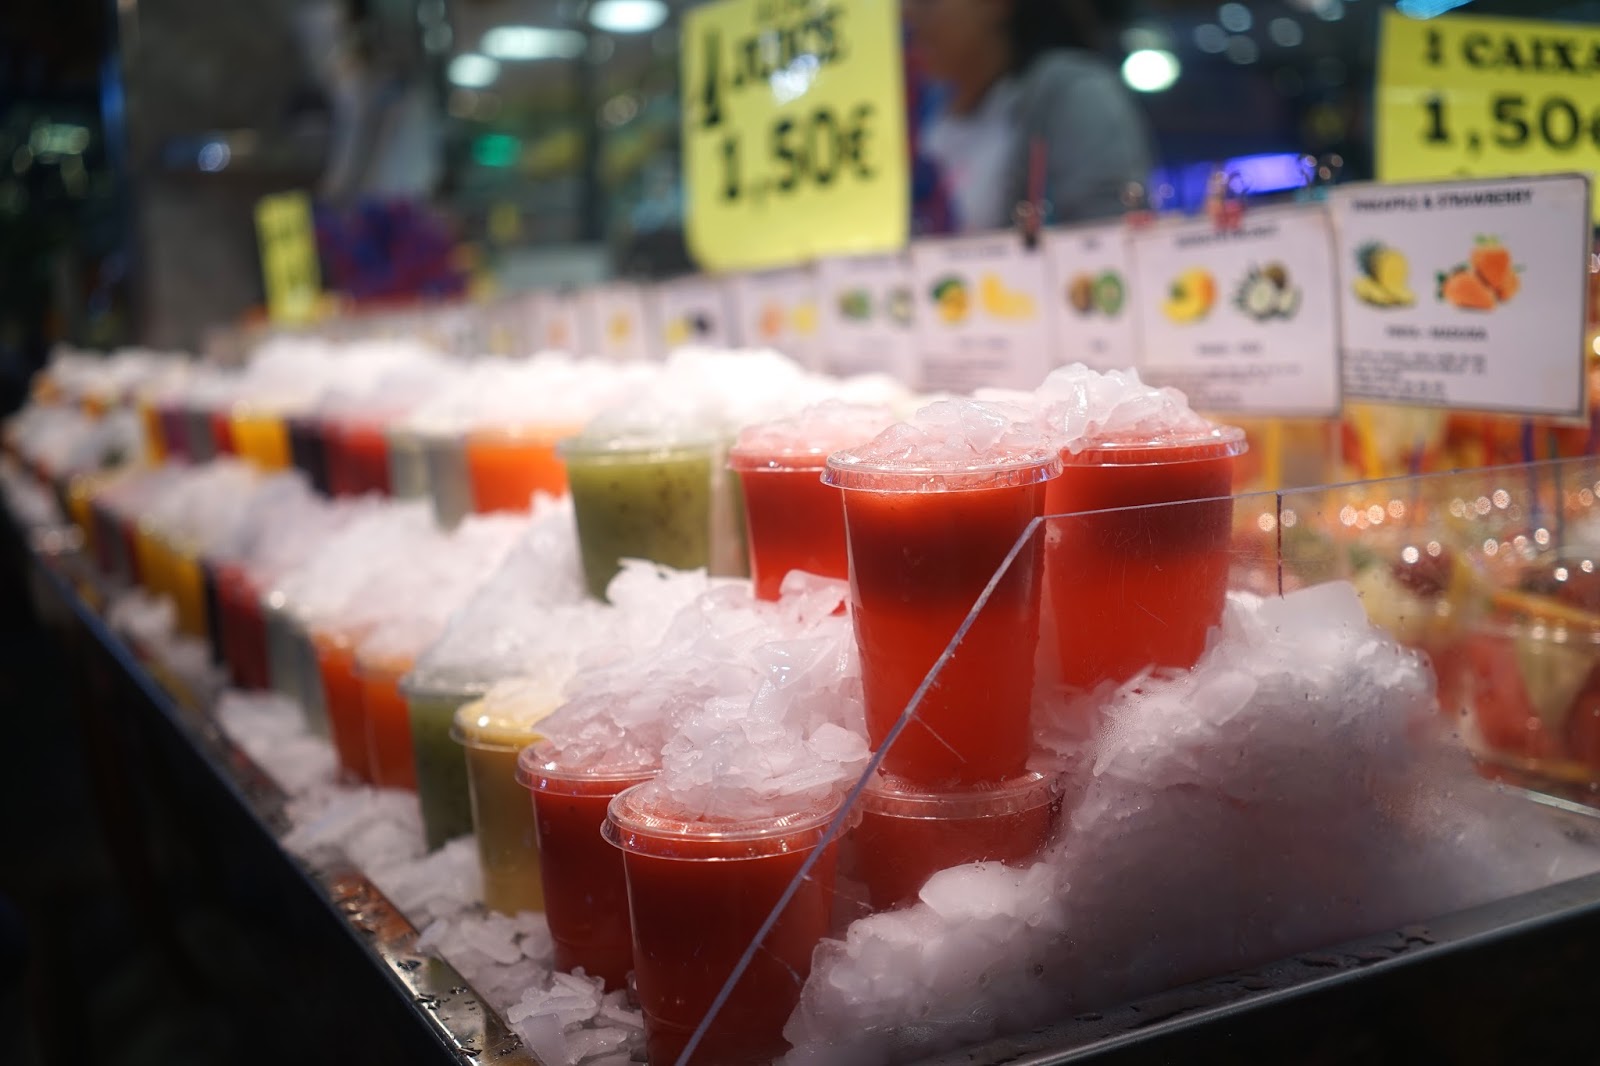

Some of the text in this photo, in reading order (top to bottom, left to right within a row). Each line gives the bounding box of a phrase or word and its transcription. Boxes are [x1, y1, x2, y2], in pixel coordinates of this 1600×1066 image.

[1425, 27, 1444, 67] 1
[722, 105, 876, 210] 1,50€
[1438, 188, 1533, 209] STRAWBERRY
